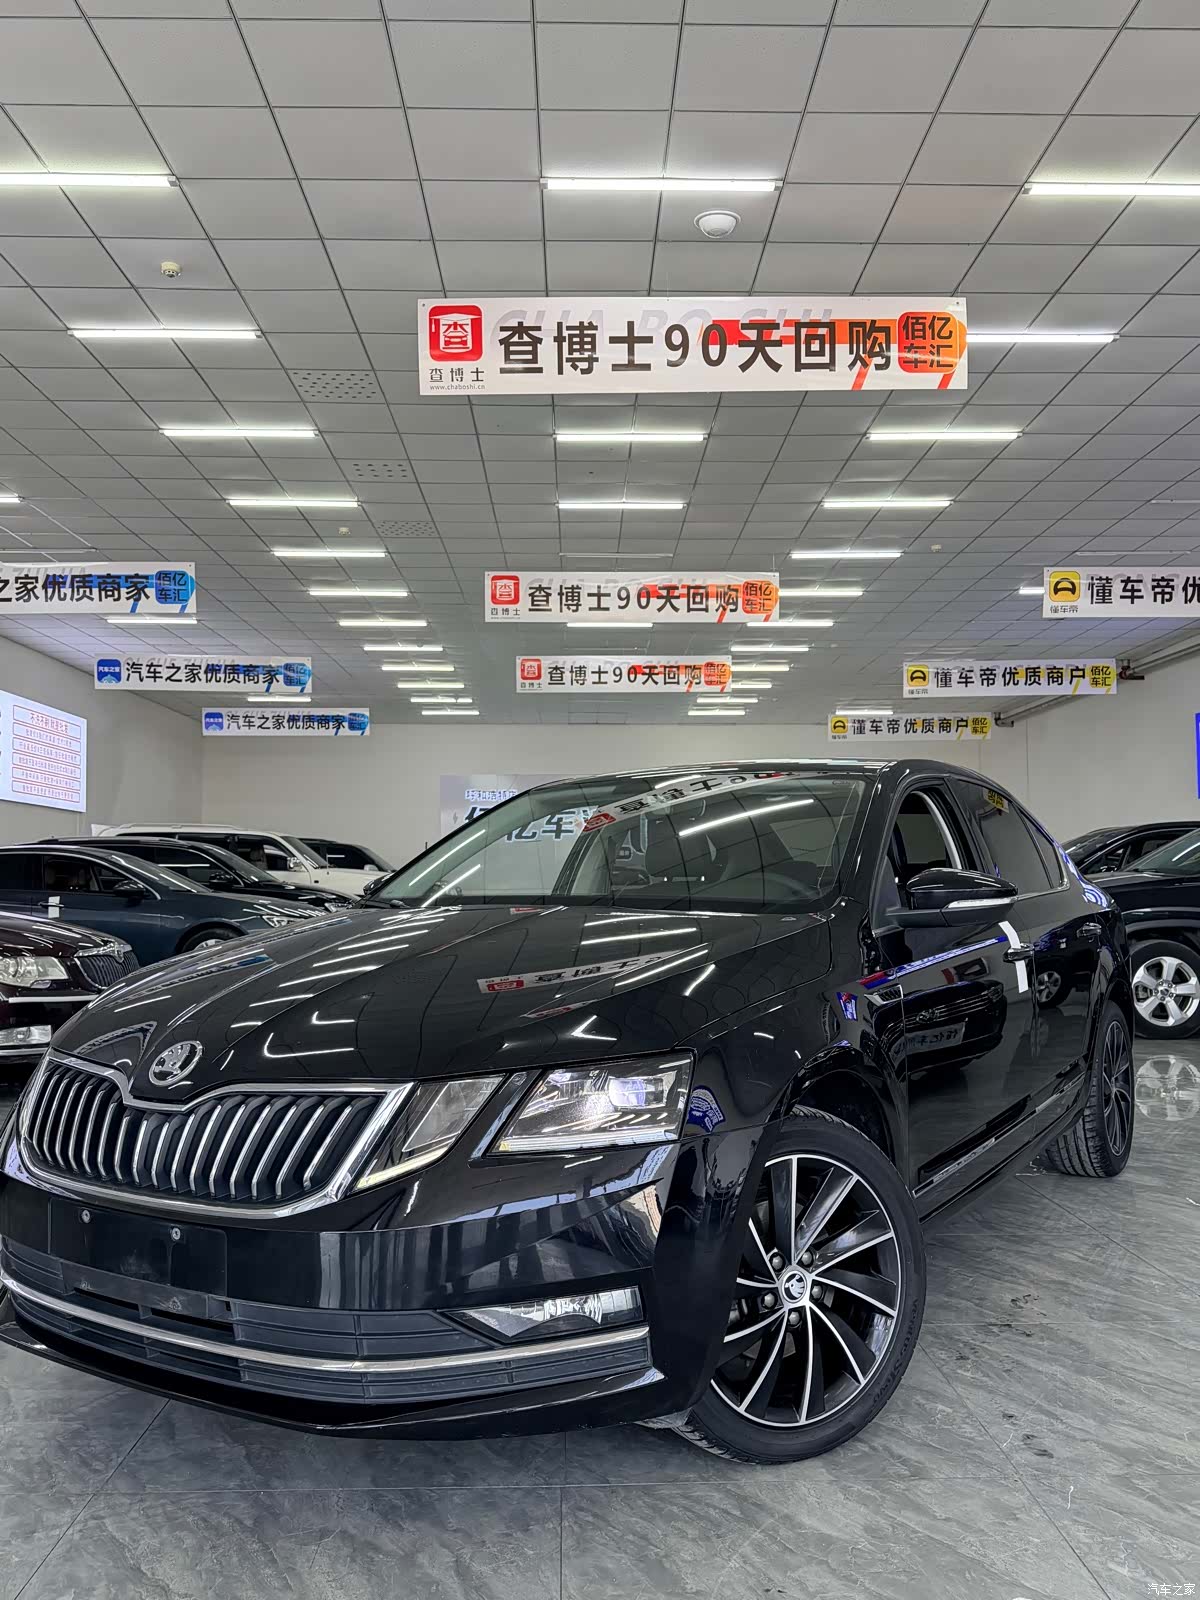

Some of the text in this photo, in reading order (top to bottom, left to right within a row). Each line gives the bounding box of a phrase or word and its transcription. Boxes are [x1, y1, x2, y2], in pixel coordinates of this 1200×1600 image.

[902, 315, 953, 341] 佰亿
[498, 319, 891, 376] 查博士90天回购
[903, 344, 954, 369] 车汇
[429, 367, 485, 383] 查博士
[429, 383, 486, 391] www.chaboshi.cn
[158, 572, 187, 586] 佰亿
[158, 588, 188, 602] 车汇
[745, 583, 772, 597] 佰亿
[1088, 575, 1200, 605] 懂车帝优
[528, 584, 739, 613] 查博士90天回购
[745, 598, 772, 612] 车汇
[491, 607, 521, 616] 查博士
[1050, 605, 1078, 614] 懂车帝
[126, 662, 280, 685] 汽车之家优质商家
[548, 664, 702, 686] 查博士90天回购
[934, 666, 1087, 688] 懂车帝优质商户
[1091, 666, 1111, 676] 佰亿
[1091, 677, 1111, 687] 车汇
[226, 713, 346, 731] 汽车之家优质商家
[851, 717, 969, 735] 懂车帝优质商户
[972, 717, 988, 726] 佰亿
[972, 726, 988, 735] 车汇
